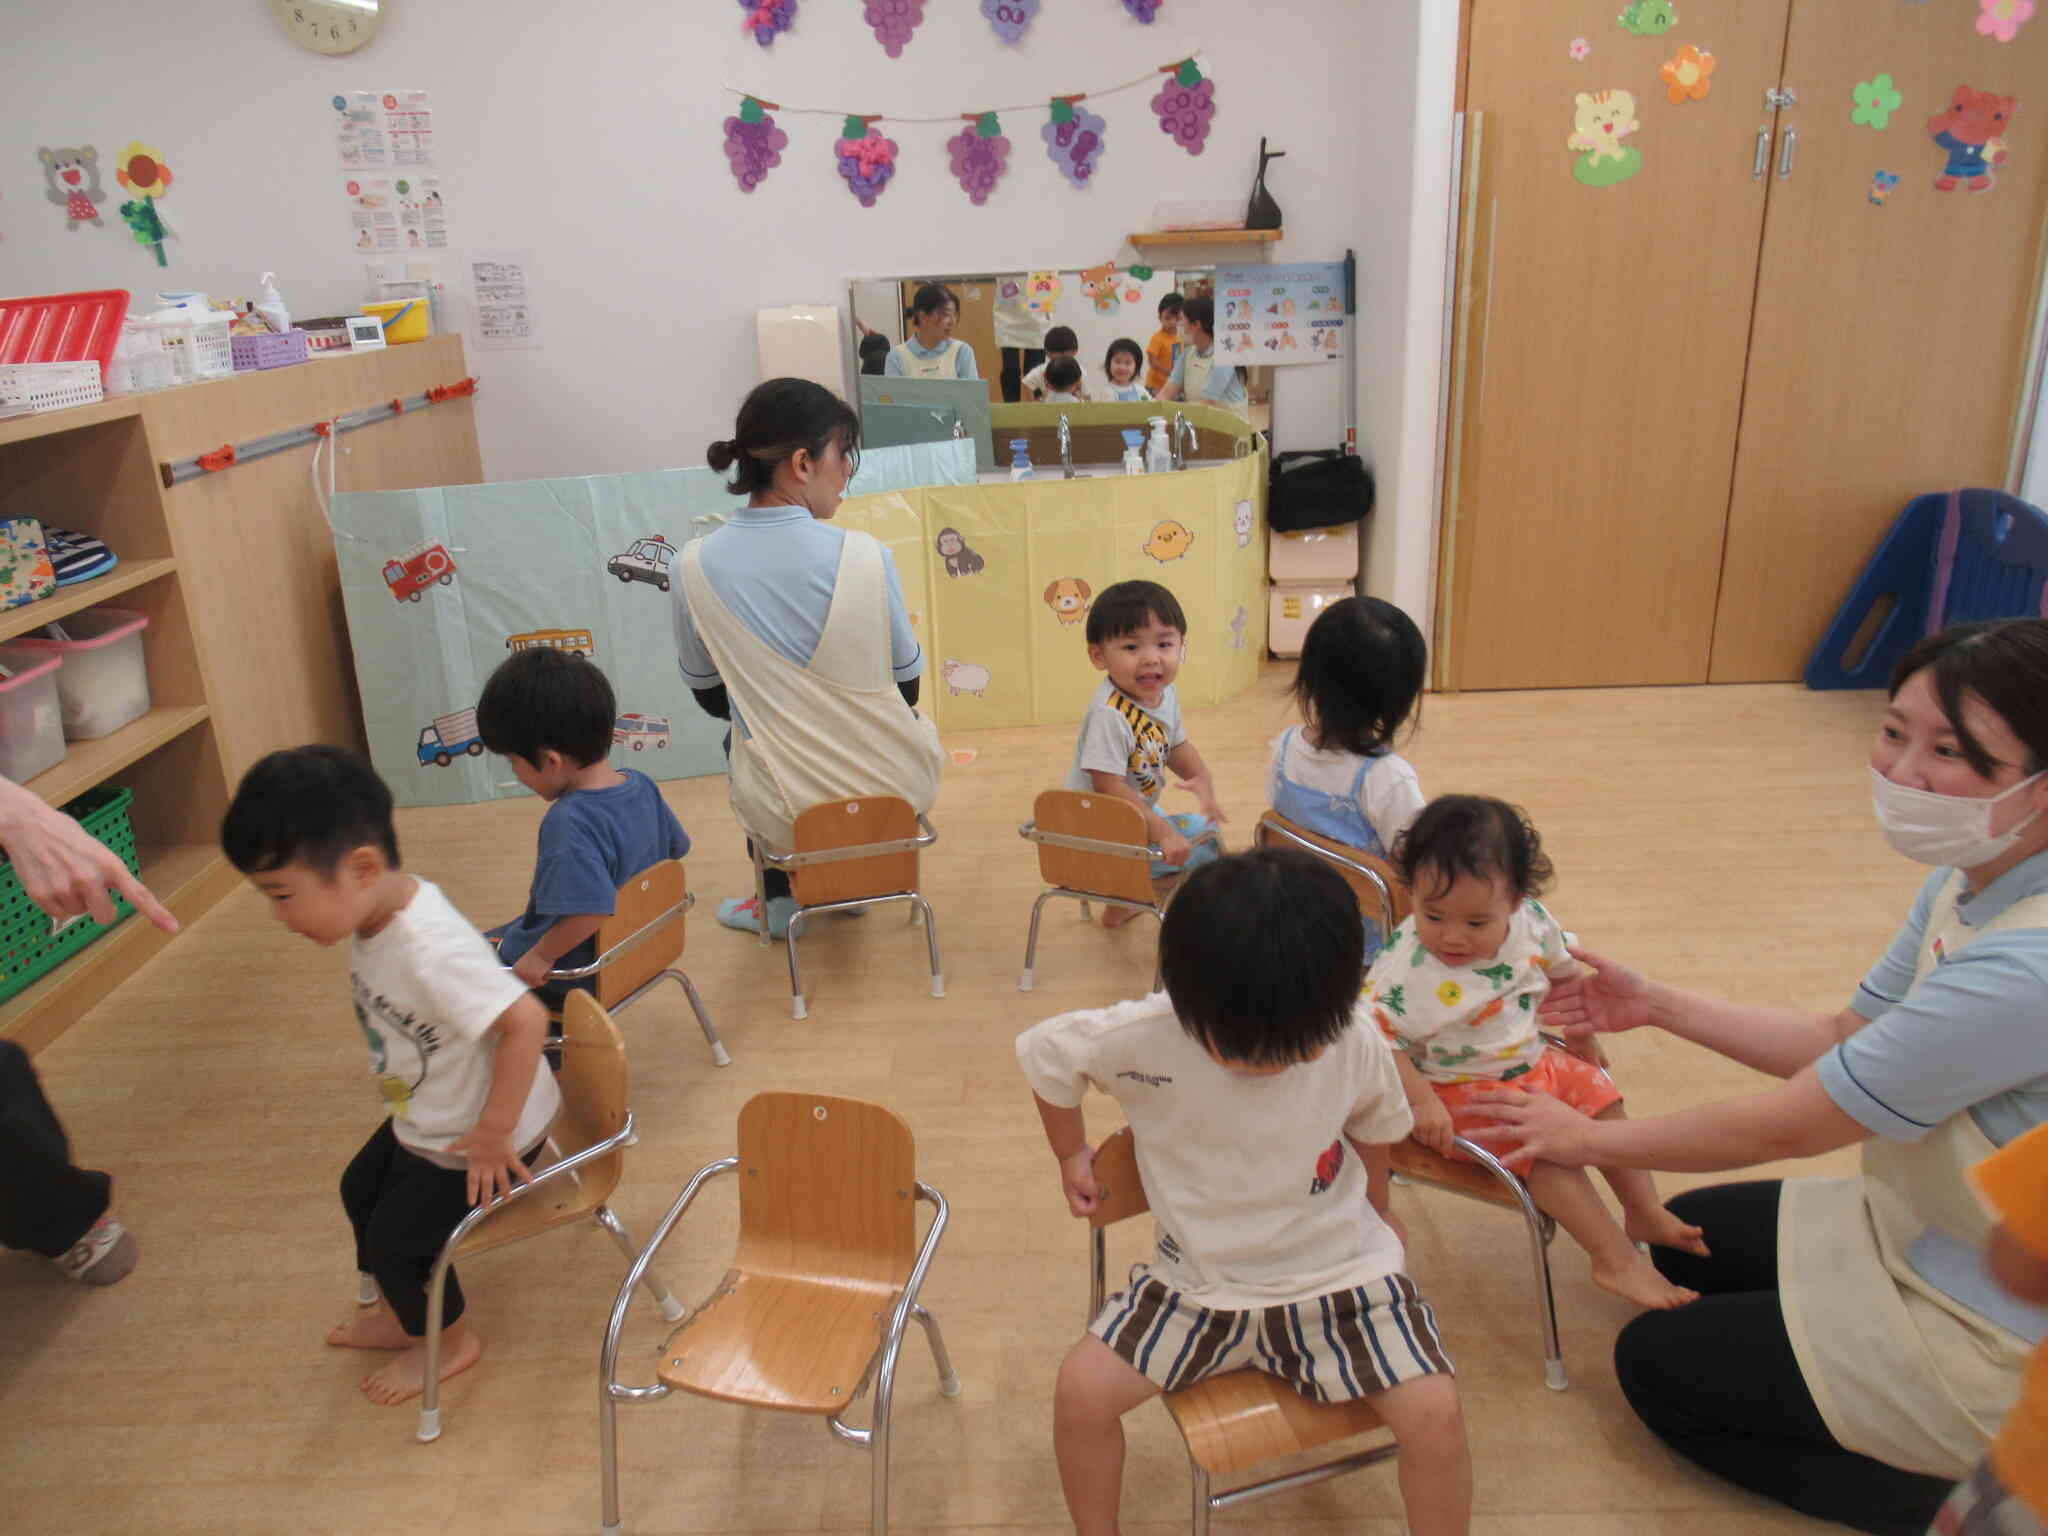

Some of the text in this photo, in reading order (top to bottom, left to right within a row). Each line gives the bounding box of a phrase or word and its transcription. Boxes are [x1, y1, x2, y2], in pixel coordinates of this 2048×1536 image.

[294, 8, 304, 23] 8
[311, 22, 319, 39] 7
[330, 24, 341, 40] 6
[348, 19, 358, 33] 5
